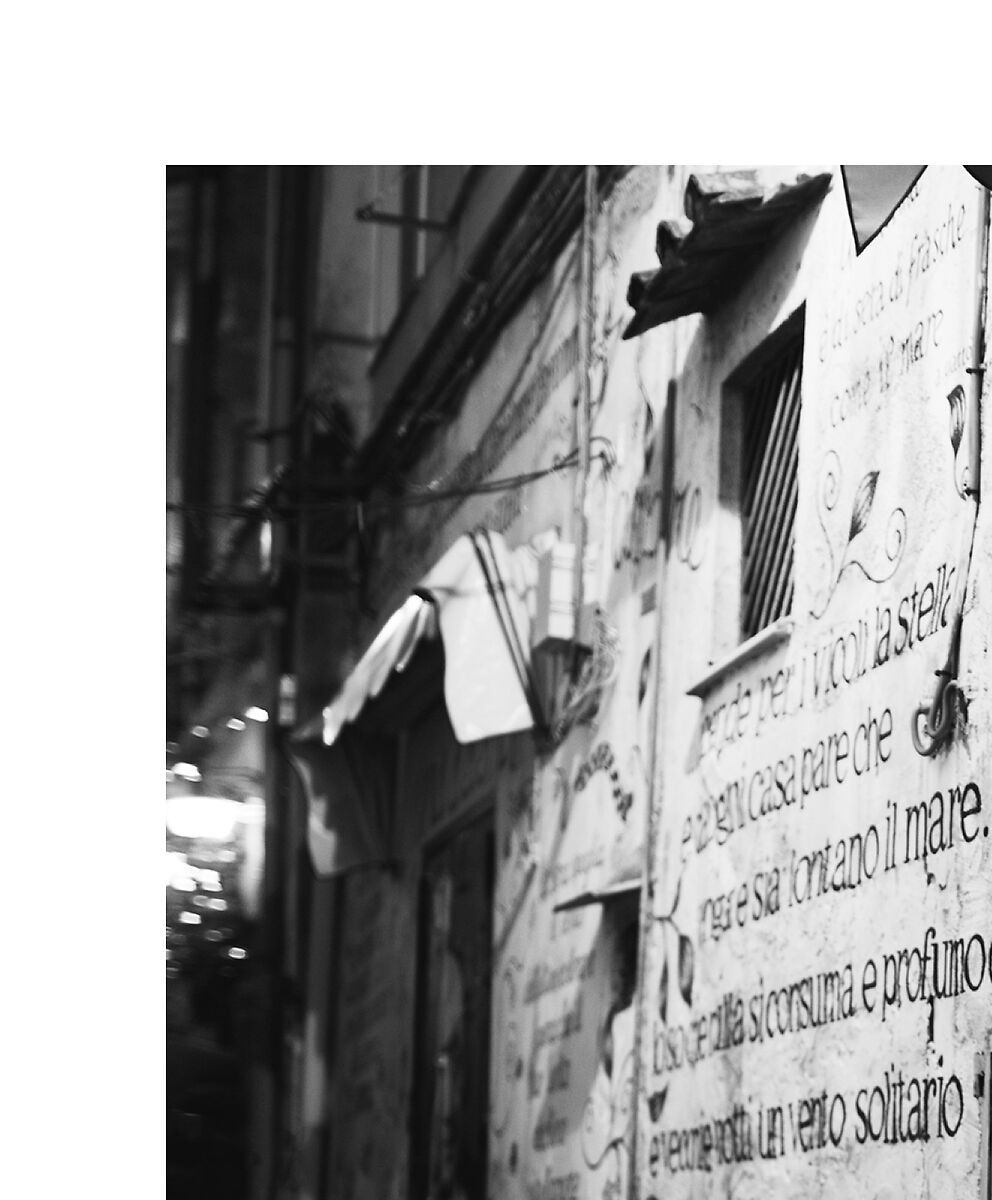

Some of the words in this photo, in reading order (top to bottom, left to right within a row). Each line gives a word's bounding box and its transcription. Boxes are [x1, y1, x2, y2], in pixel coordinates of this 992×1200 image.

[873, 605, 892, 670] la
[748, 755, 796, 822] casa
[802, 731, 849, 809] pare
[853, 708, 893, 776] che
[788, 824, 880, 907] lontano
[884, 800, 897, 873] il
[904, 781, 989, 864] mare.
[766, 963, 855, 1038] consuma
[862, 959, 877, 1013] e
[882, 927, 986, 1022] profumo
[788, 1089, 846, 1152] vento
[855, 1055, 964, 1144] solitario
